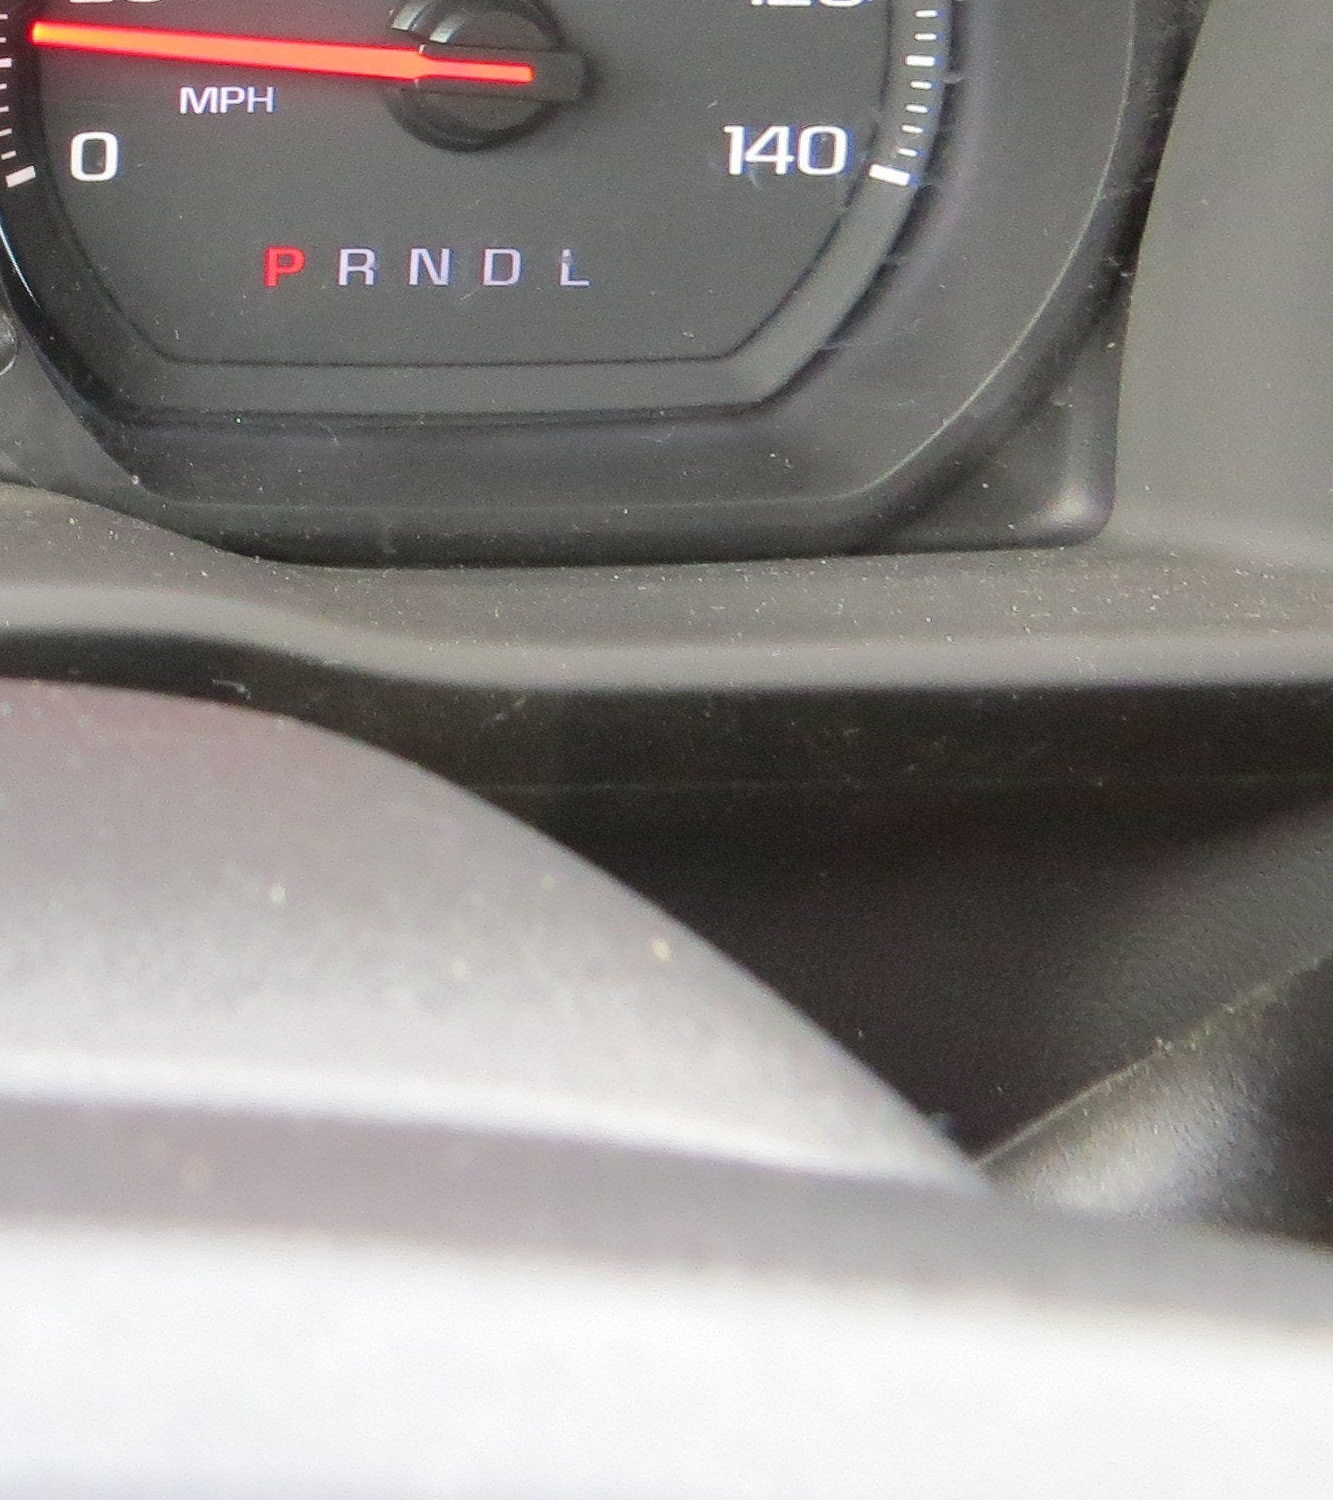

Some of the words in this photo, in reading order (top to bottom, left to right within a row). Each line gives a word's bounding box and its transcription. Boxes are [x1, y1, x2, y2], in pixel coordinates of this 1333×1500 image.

[179, 86, 274, 114] MPH
[70, 131, 119, 182] 0
[723, 125, 849, 176] 140
[264, 246, 305, 287] P
[338, 248, 376, 286] R
[408, 248, 450, 286] N
[483, 248, 522, 286] D
[560, 248, 590, 286] L
